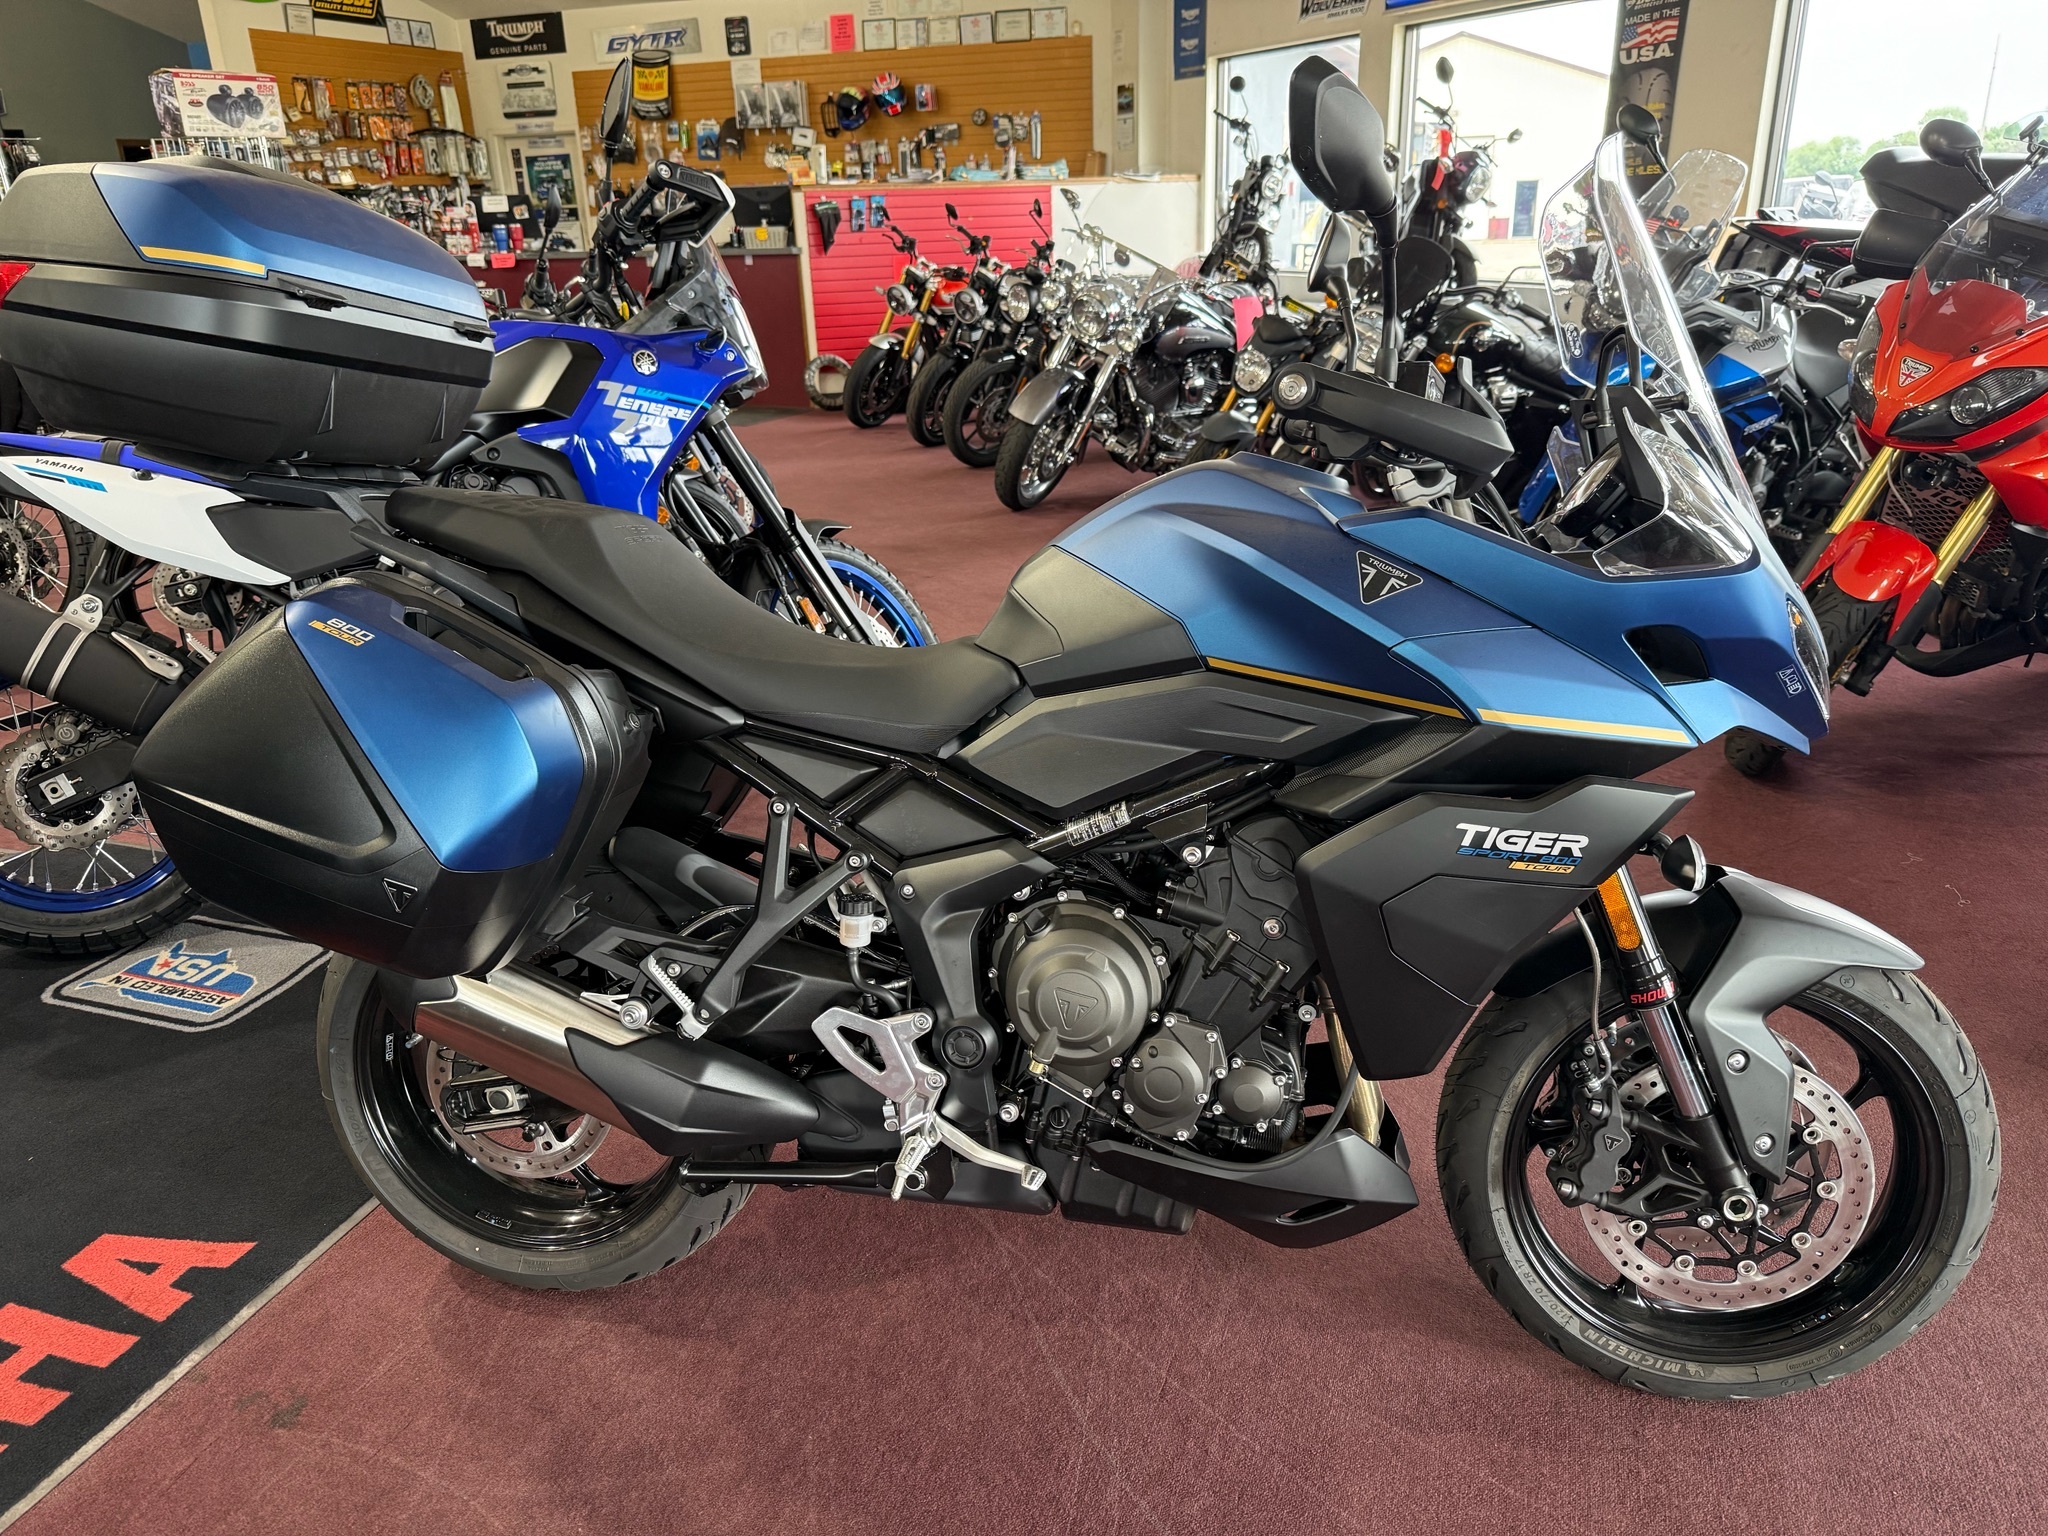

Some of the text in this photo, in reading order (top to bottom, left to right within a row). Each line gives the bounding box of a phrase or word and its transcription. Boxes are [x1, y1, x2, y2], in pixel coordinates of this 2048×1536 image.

[315, 1, 341, 10] UTILITY
[342, 5, 373, 14] DIVISION
[1624, 7, 1681, 26] MADE IN THE
[486, 19, 545, 42] TRIUMPH
[606, 28, 688, 54] GYTR
[489, 43, 548, 55] GENUINE PARTS
[1619, 42, 1675, 65] U.S.A.
[1745, 334, 1782, 353] TRIUMPH
[35, 457, 85, 473] YAMAHA
[1368, 557, 1409, 580] TRIUMPH
[322, 624, 361, 645] TOUR
[326, 617, 375, 642] 800
[1455, 822, 1590, 857] TIGER
[1455, 847, 1582, 866] SPORT 800
[1522, 863, 1573, 873] TOUR
[147, 949, 241, 987] USA
[108, 974, 236, 1004] ASSEMBLED IN
[1583, 1328, 1682, 1373] MICHELIN
